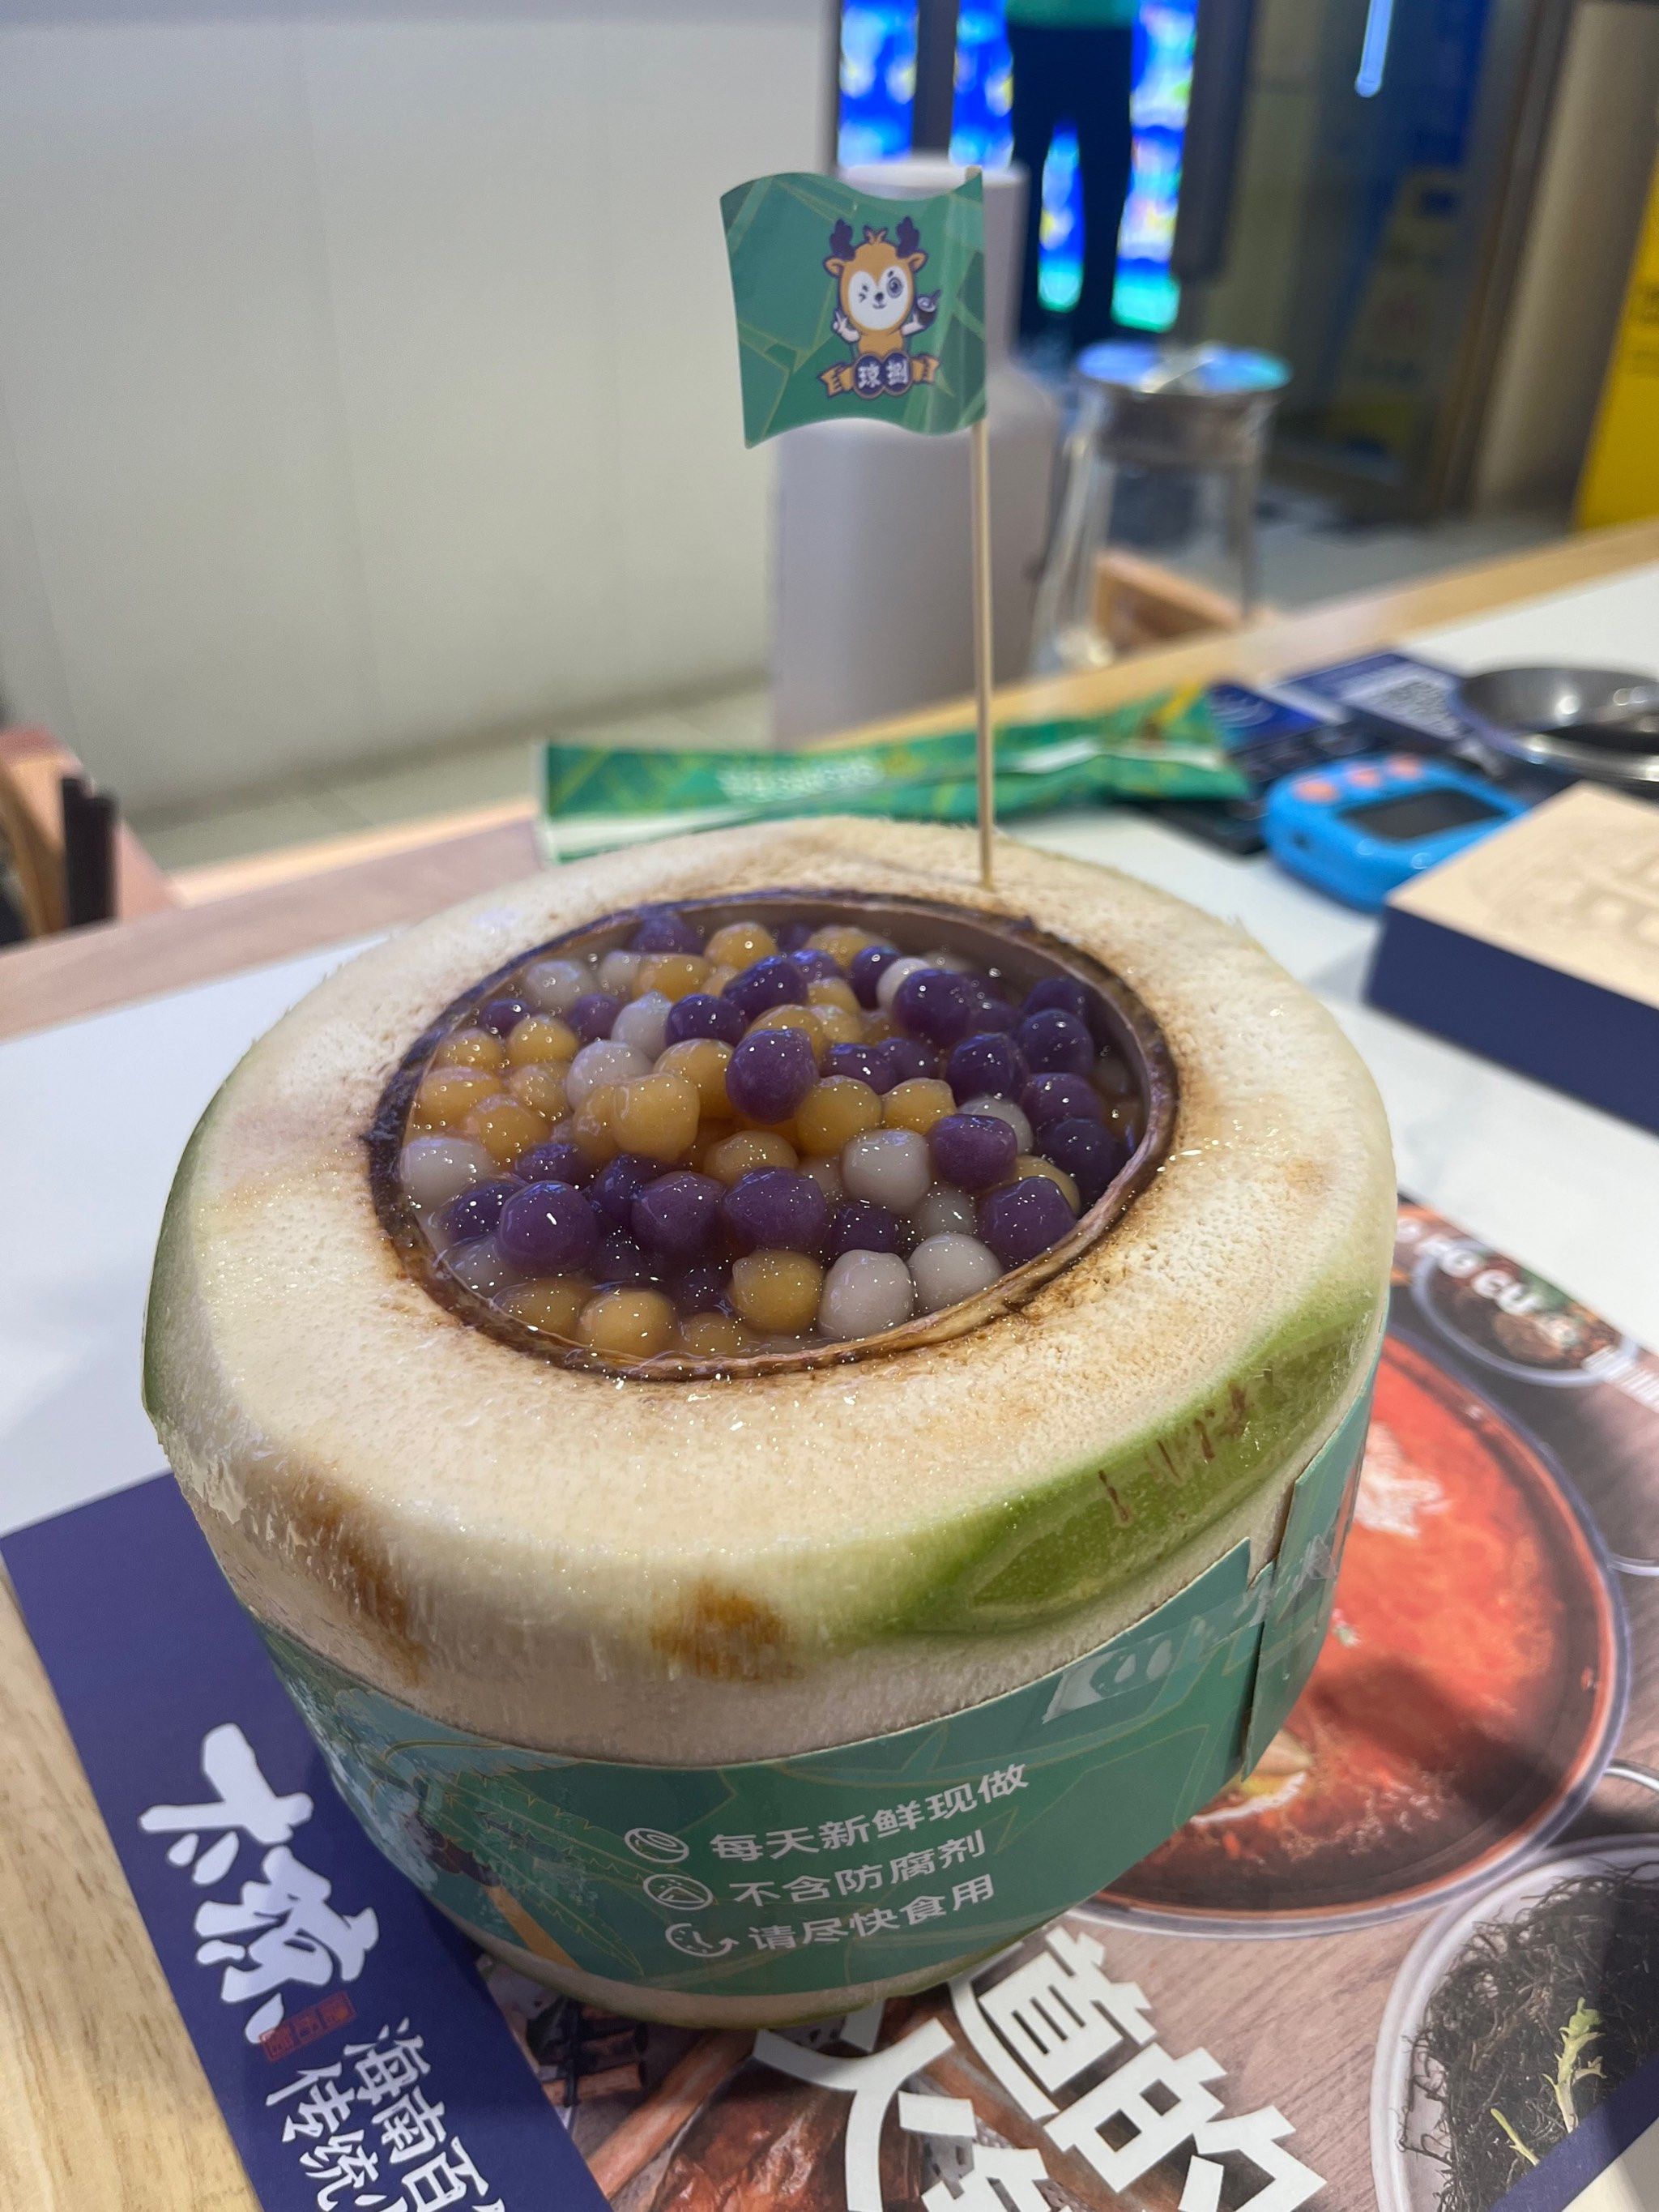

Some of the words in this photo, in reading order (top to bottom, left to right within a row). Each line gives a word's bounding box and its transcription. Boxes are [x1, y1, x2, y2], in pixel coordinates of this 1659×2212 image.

[710, 1763, 1030, 1863] 每天新鲜现做
[729, 1829, 986, 1907] 不含防腐剂
[748, 1873, 994, 1952] 请尽快食用
[343, 2017, 505, 2212] 海南百
